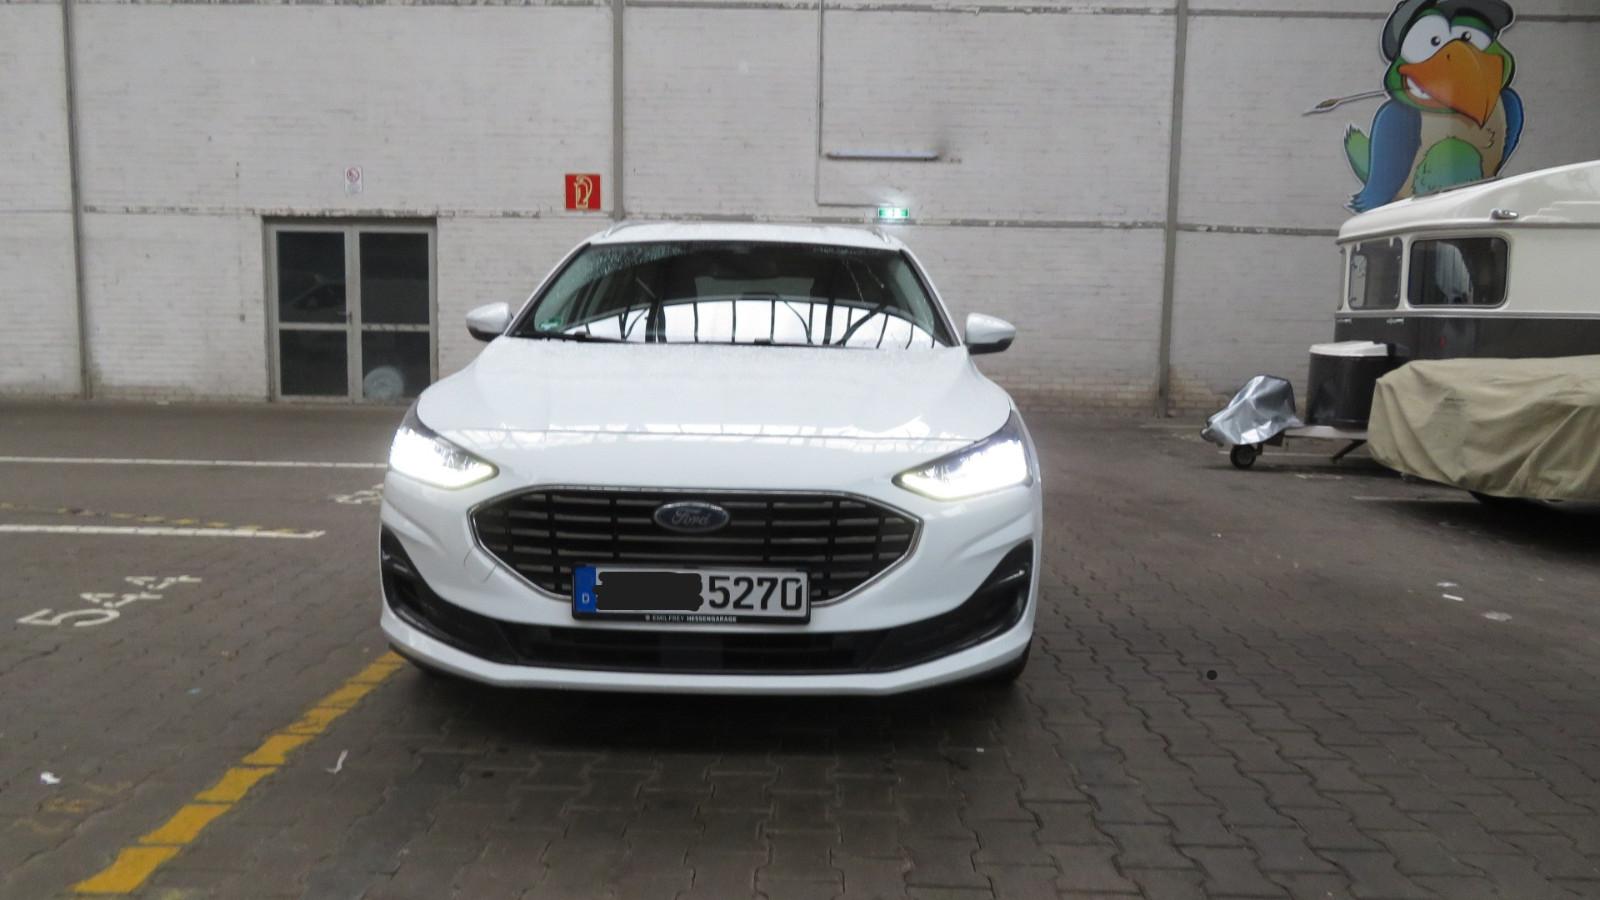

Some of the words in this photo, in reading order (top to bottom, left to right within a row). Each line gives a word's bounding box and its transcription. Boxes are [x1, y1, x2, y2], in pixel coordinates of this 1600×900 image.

[672, 508, 712, 528] Ford
[582, 592, 590, 605] D
[708, 575, 803, 611] 5270
